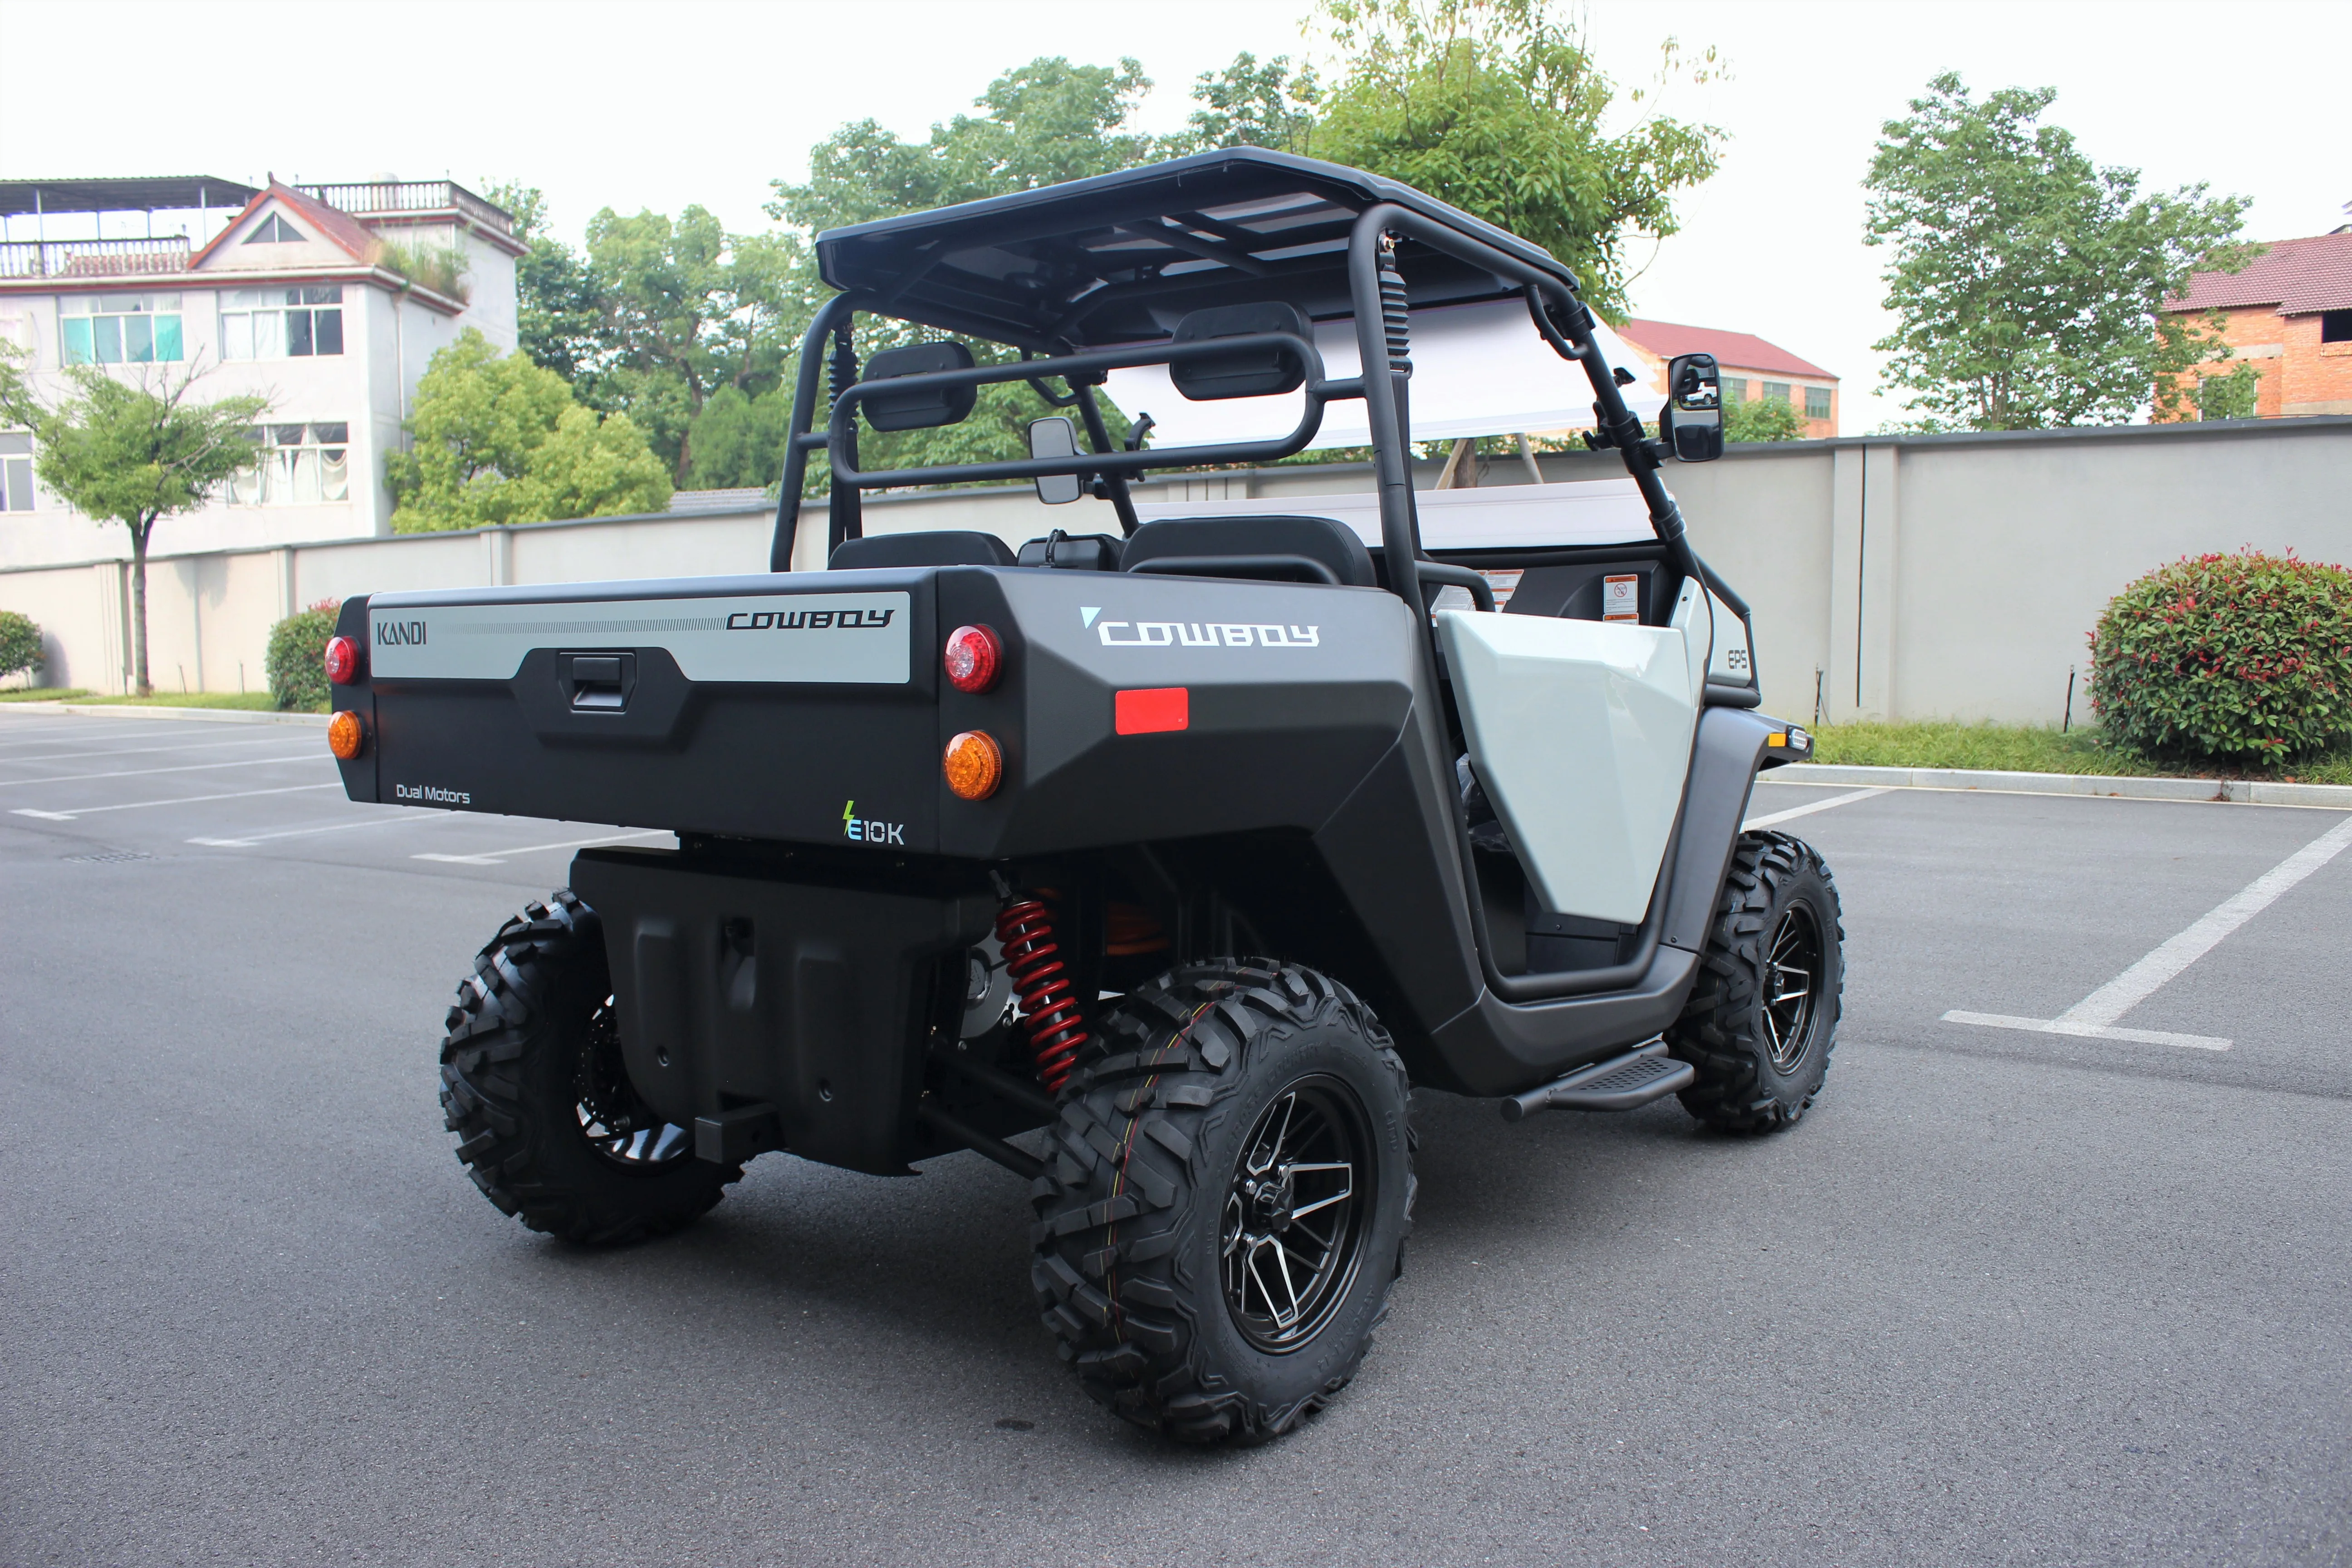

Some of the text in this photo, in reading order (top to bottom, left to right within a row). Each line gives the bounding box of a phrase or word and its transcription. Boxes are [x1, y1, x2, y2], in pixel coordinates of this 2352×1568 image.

[726, 609, 895, 630] COWBOY
[377, 622, 426, 645] KANDI
[1098, 621, 1319, 647] COWBOY
[1728, 650, 1747, 669] EPS
[396, 784, 470, 804] Dual Motors
[848, 819, 905, 845] E10K
